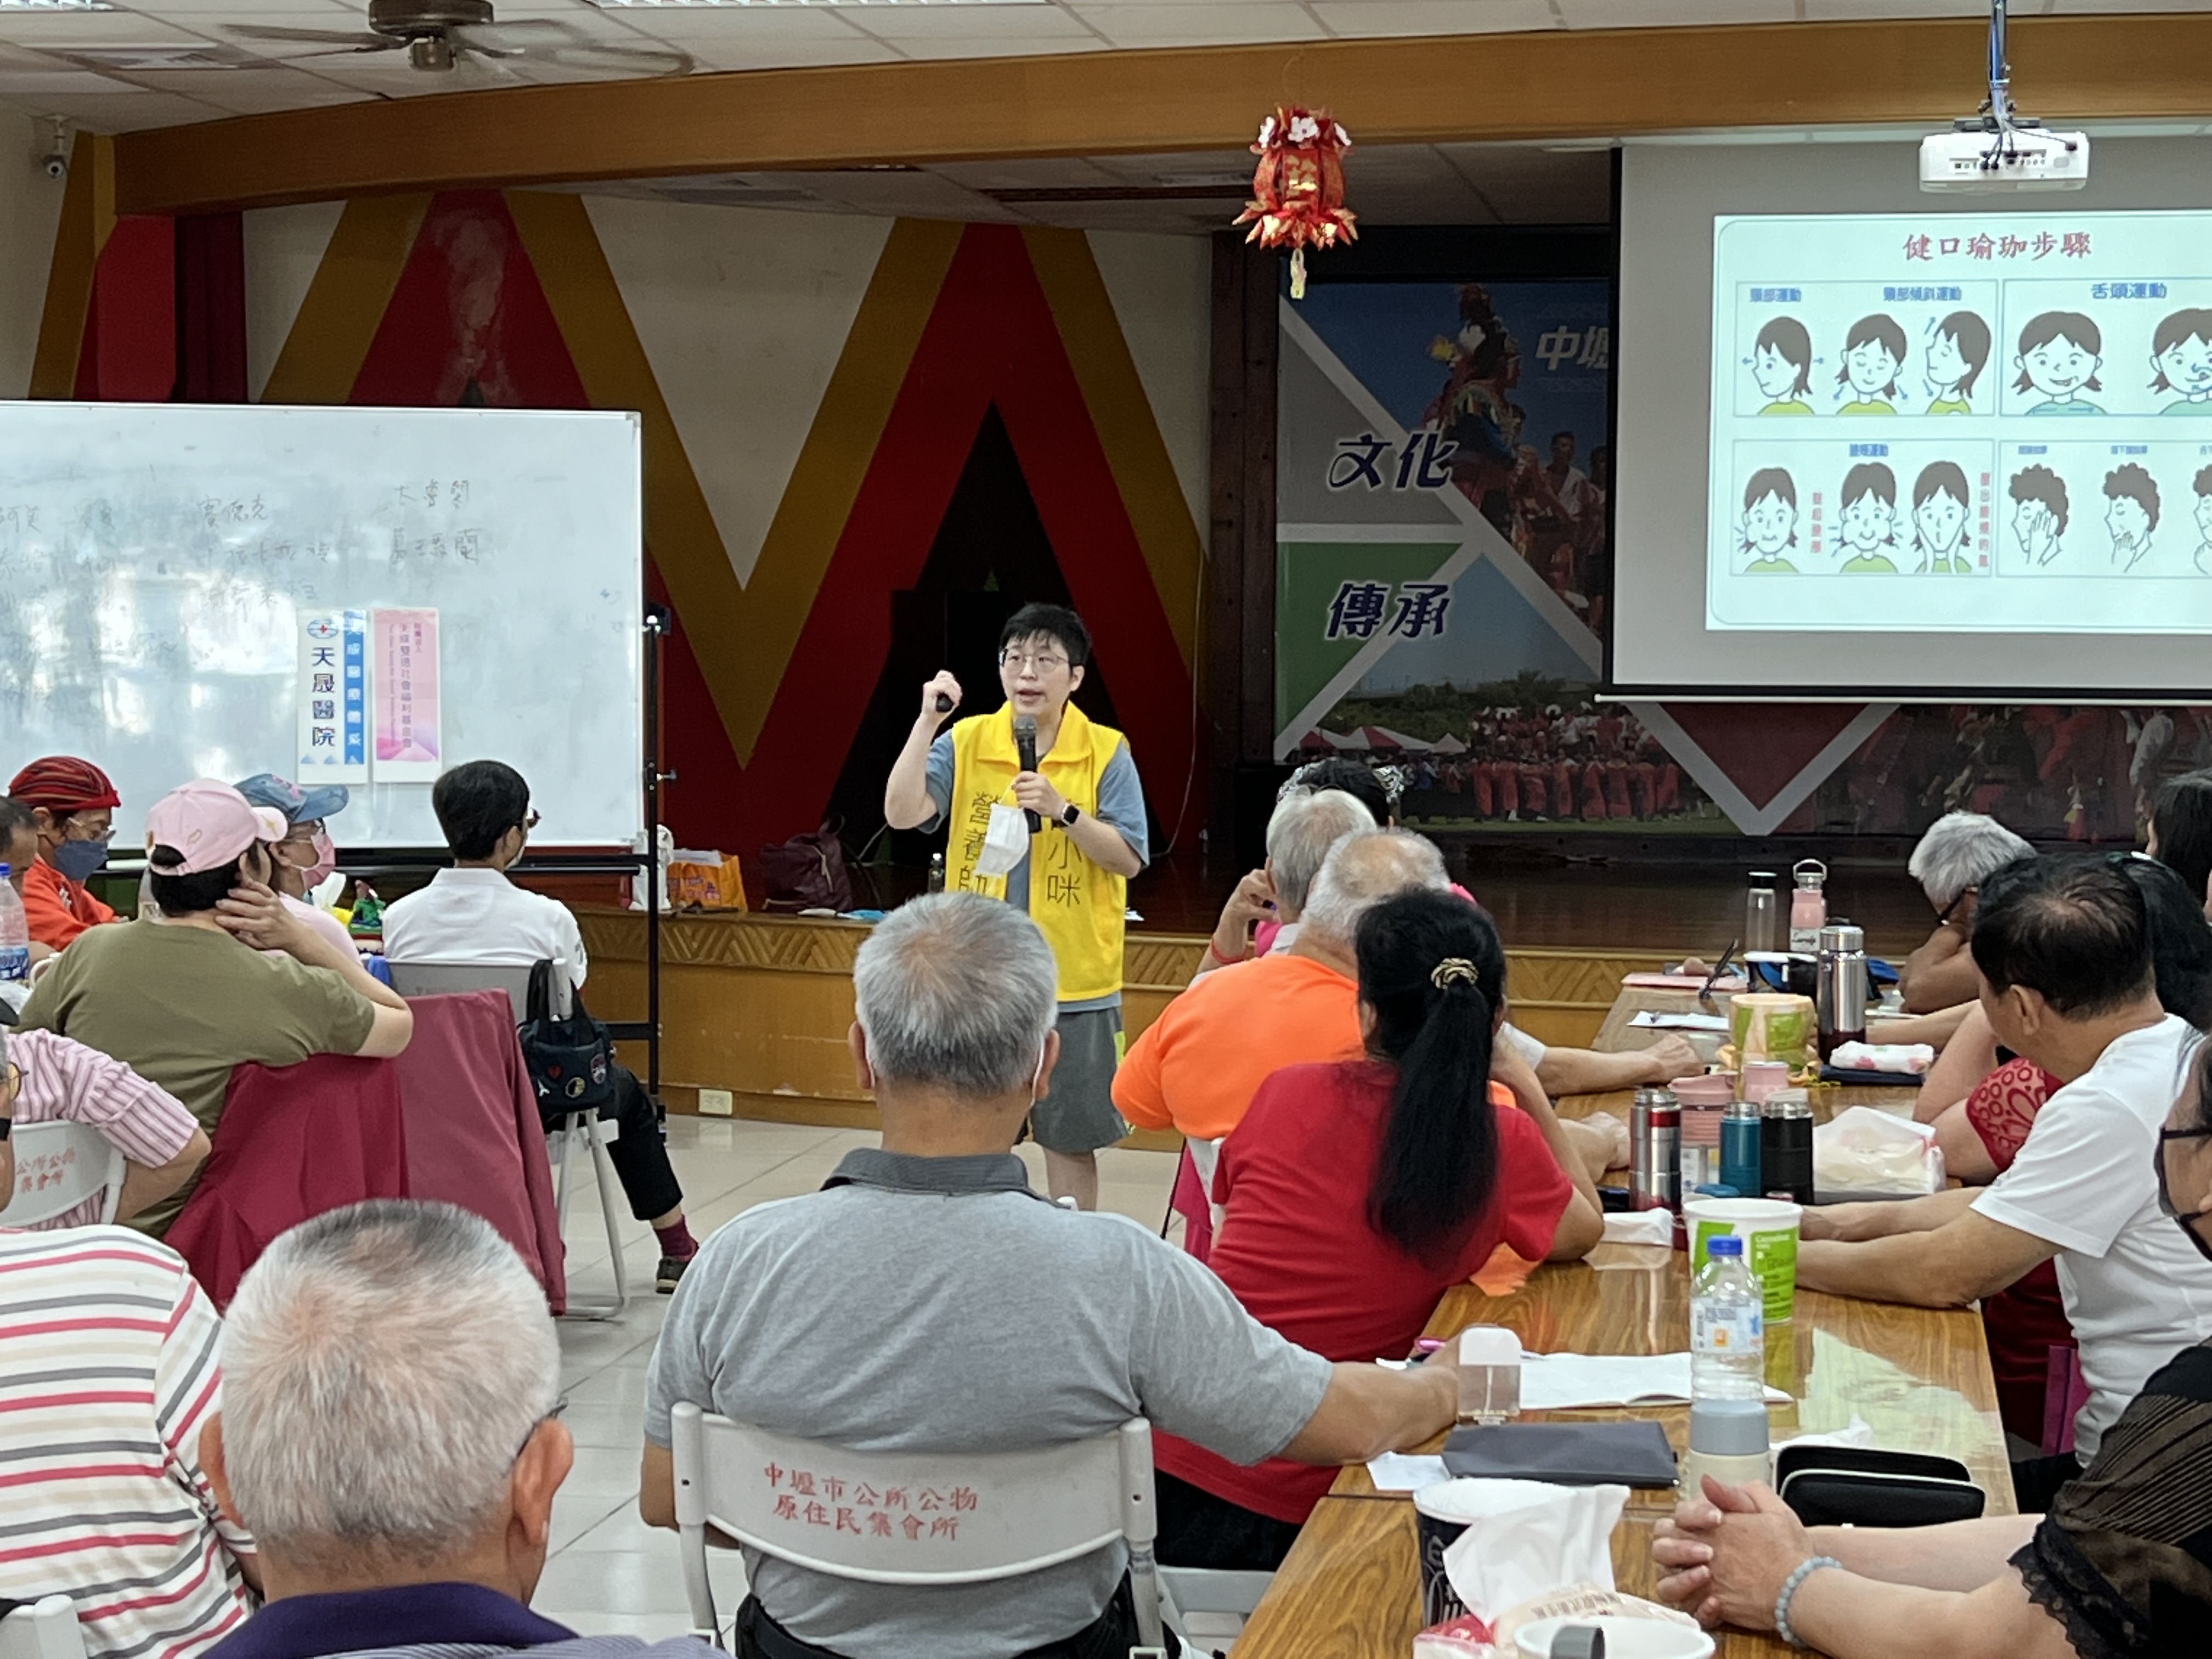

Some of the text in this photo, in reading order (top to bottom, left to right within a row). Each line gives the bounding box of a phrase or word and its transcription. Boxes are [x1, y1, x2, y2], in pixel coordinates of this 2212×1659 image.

[1903, 231, 2092, 261] 健口瑜珈步驟
[2091, 282, 2167, 300] 舌頭運動
[1329, 433, 1459, 489] 文化
[1326, 582, 1450, 639] 傳承
[312, 647, 335, 747] 天晟醫院
[764, 1462, 978, 1512] 中壢市公所公物
[773, 1494, 960, 1541] 原住民集會所
